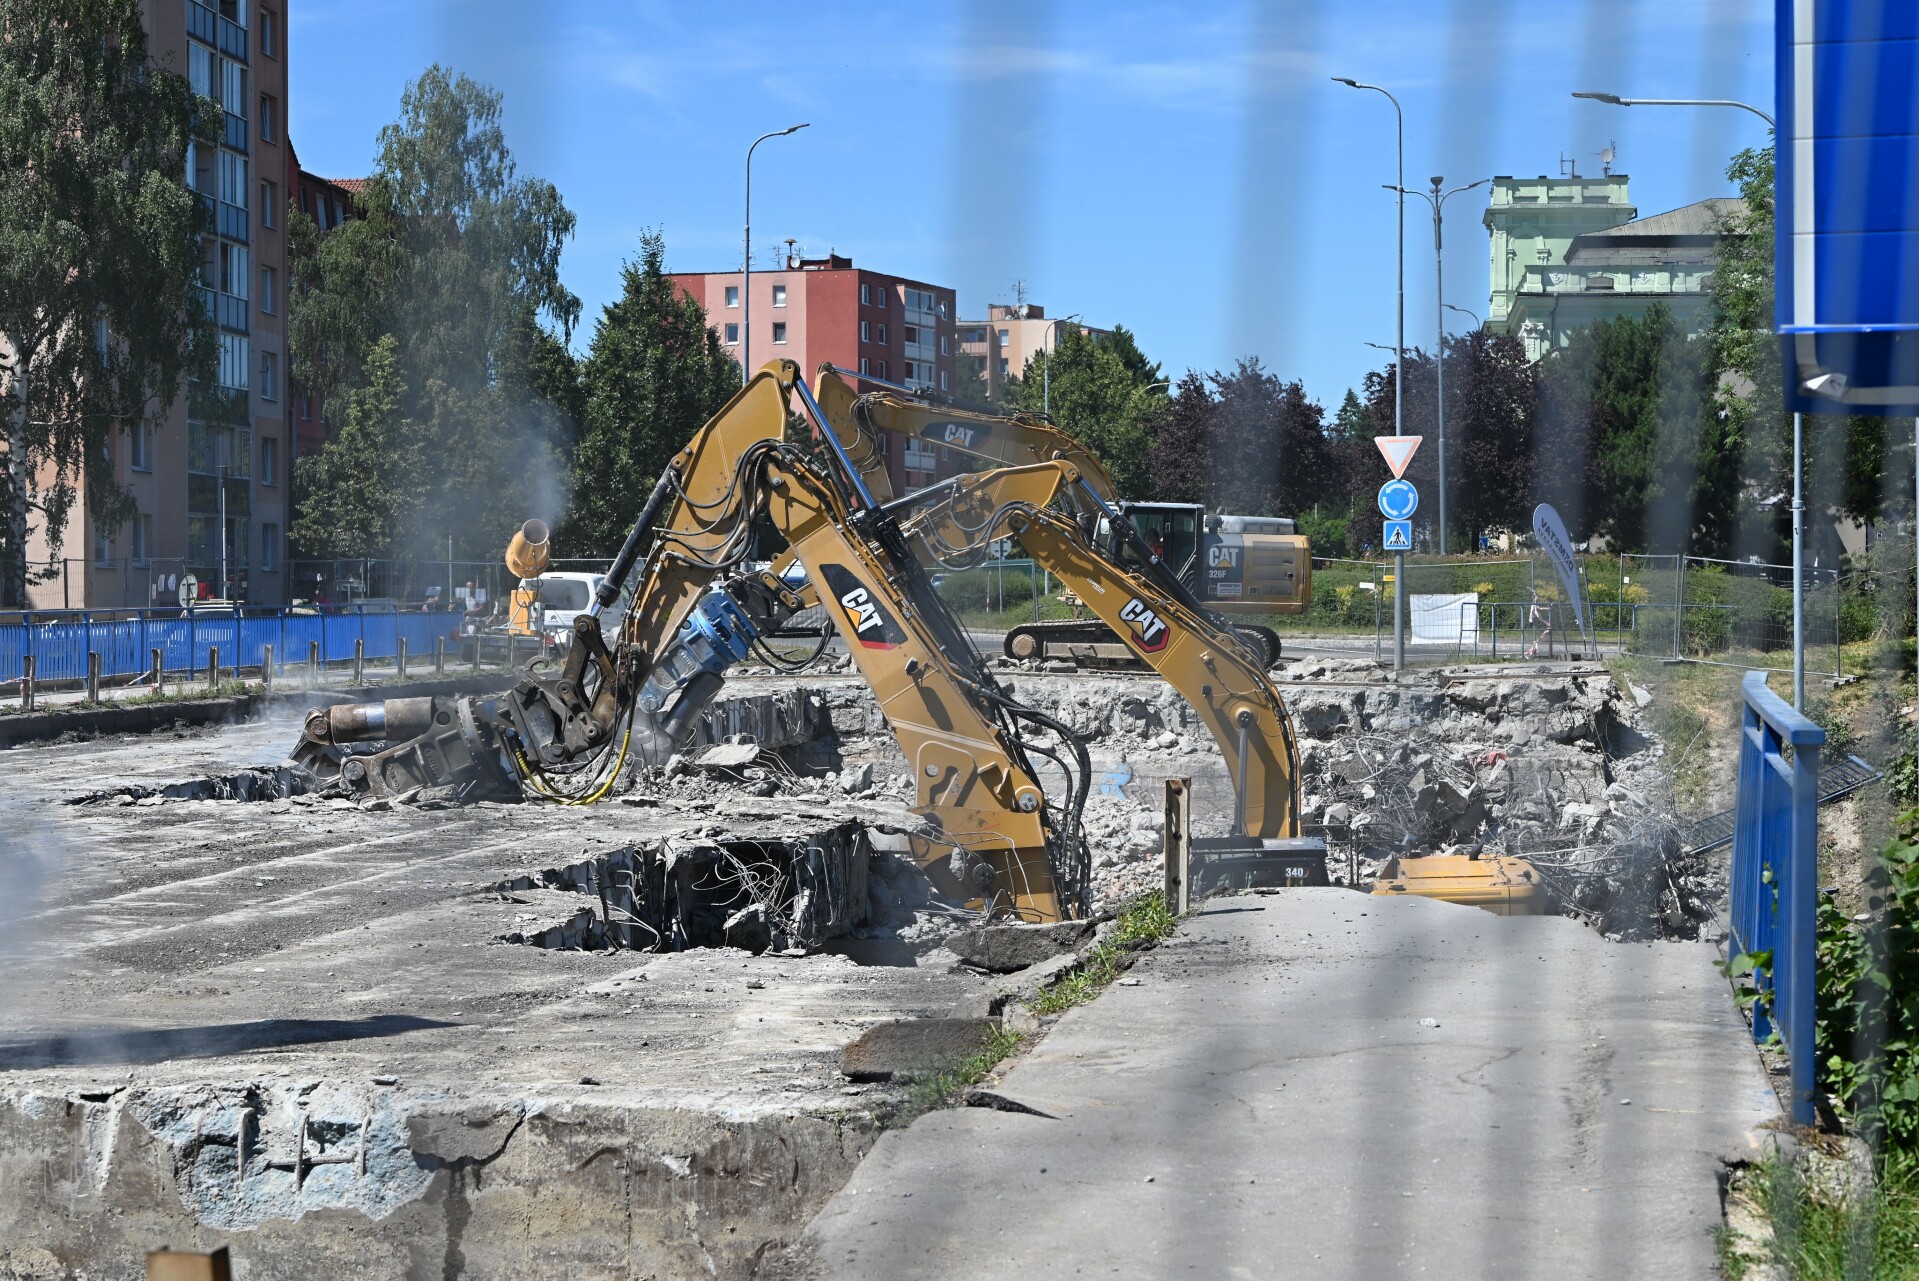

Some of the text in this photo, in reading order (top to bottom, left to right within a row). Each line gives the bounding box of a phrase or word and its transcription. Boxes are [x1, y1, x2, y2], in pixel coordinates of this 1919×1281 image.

[945, 424, 975, 447] CAT
[1209, 547, 1239, 567] CAT
[1208, 570, 1226, 578] 326F
[842, 587, 884, 633] CAT
[1119, 599, 1167, 641] CAT
[1285, 867, 1304, 877] 340
